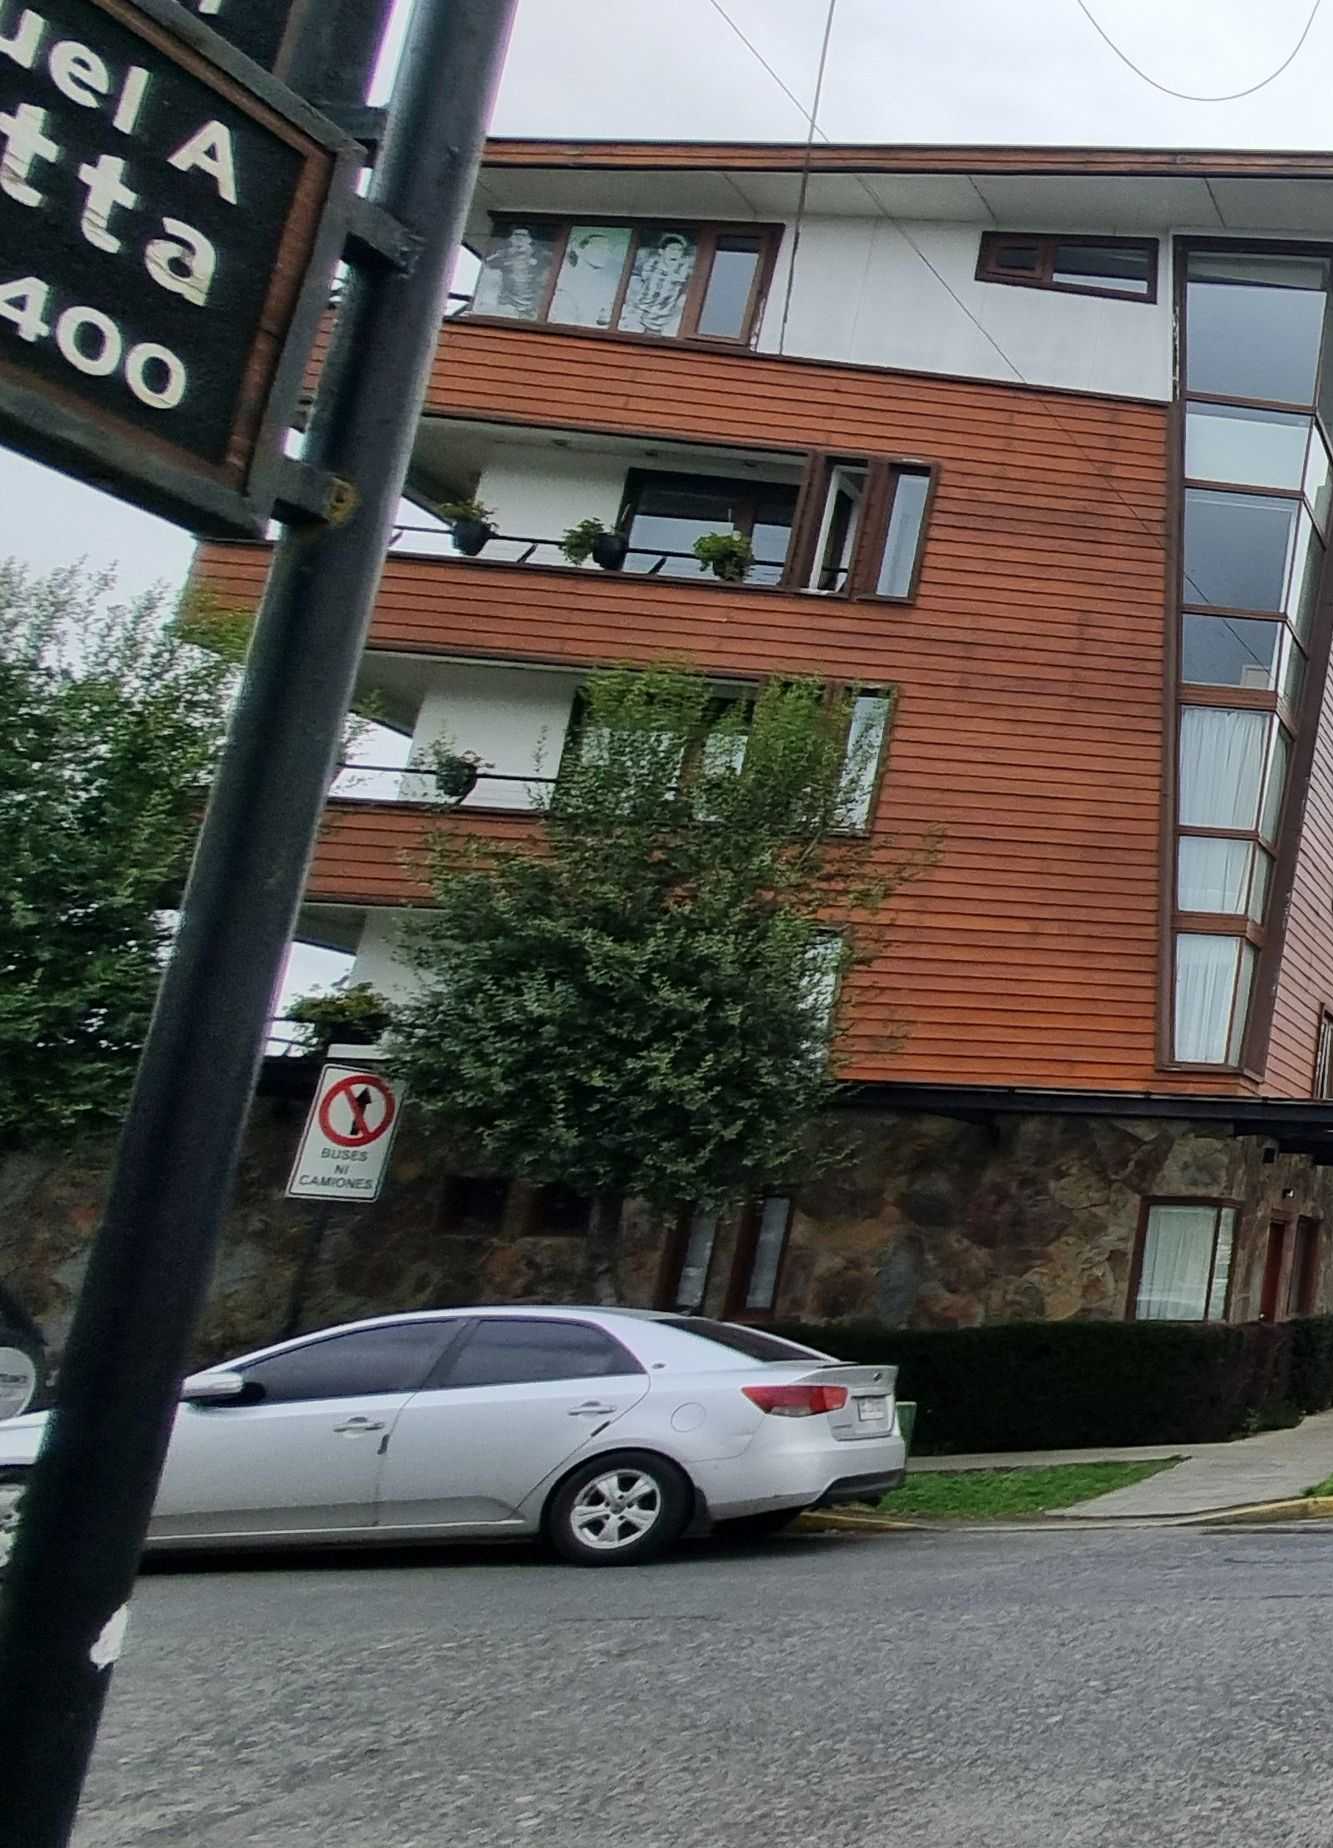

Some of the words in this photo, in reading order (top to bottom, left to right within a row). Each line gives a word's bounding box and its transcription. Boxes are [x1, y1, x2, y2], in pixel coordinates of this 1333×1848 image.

[167, 120, 237, 205] A
[320, 1148, 368, 1162] BUSES
[334, 1164, 349, 1174] NI
[300, 1174, 374, 1190] CAMIONES
